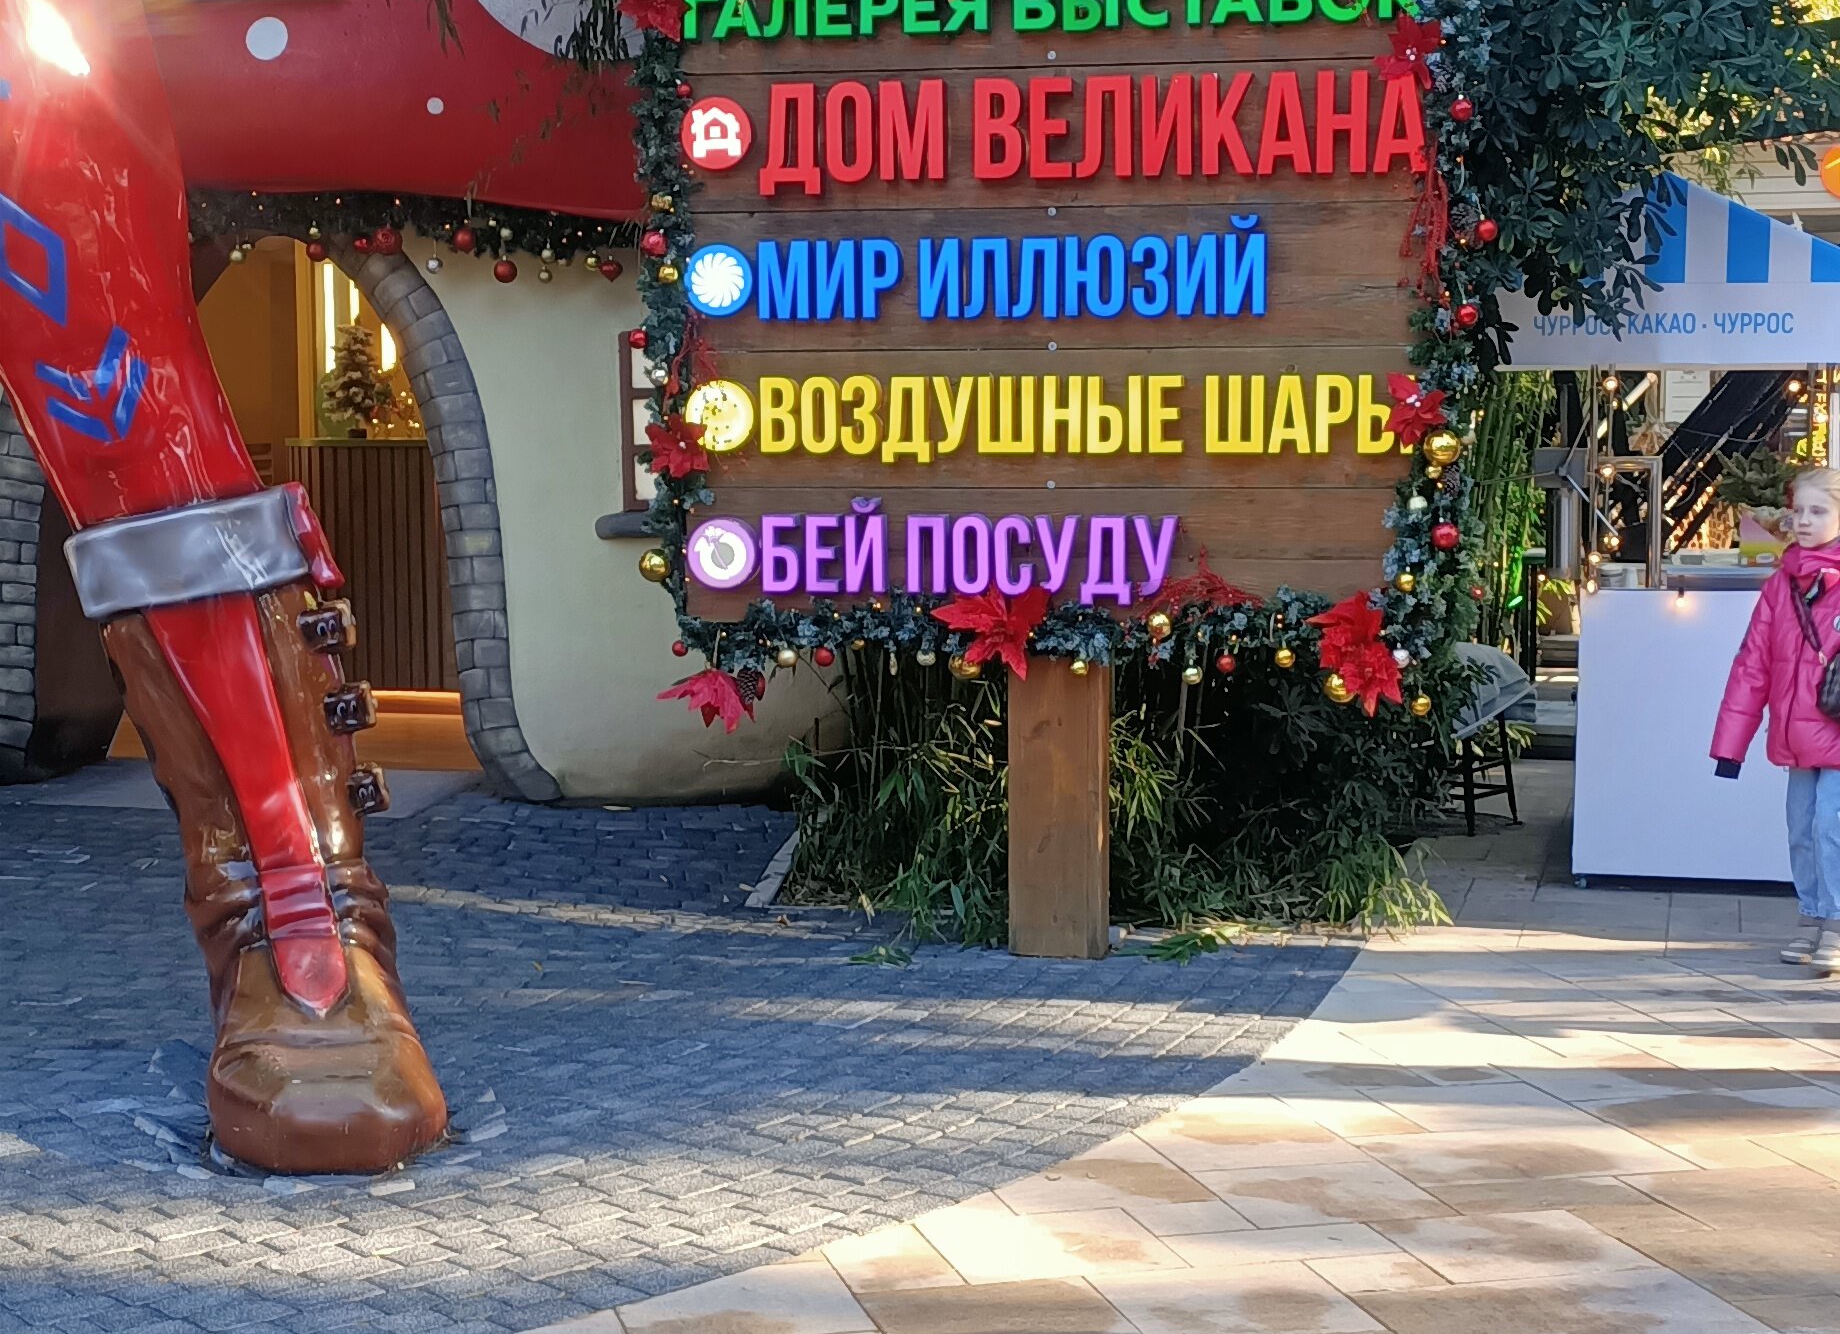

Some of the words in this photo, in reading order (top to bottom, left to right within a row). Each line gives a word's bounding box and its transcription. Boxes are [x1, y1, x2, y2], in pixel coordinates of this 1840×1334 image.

[759, 79, 944, 195] ДОМ
[973, 70, 1428, 181] ВЕЛИКАНА
[757, 238, 901, 322] МИР
[917, 214, 1268, 320] ИЛЛЮЗИЙ
[1627, 312, 1697, 335] КАКАО
[1713, 312, 1794, 335] ЧУРРОС
[758, 374, 1185, 463] ВОЗДУШНЫЕ
[760, 498, 888, 594] БЕЙ
[906, 512, 1178, 605] ПОСУДУ
